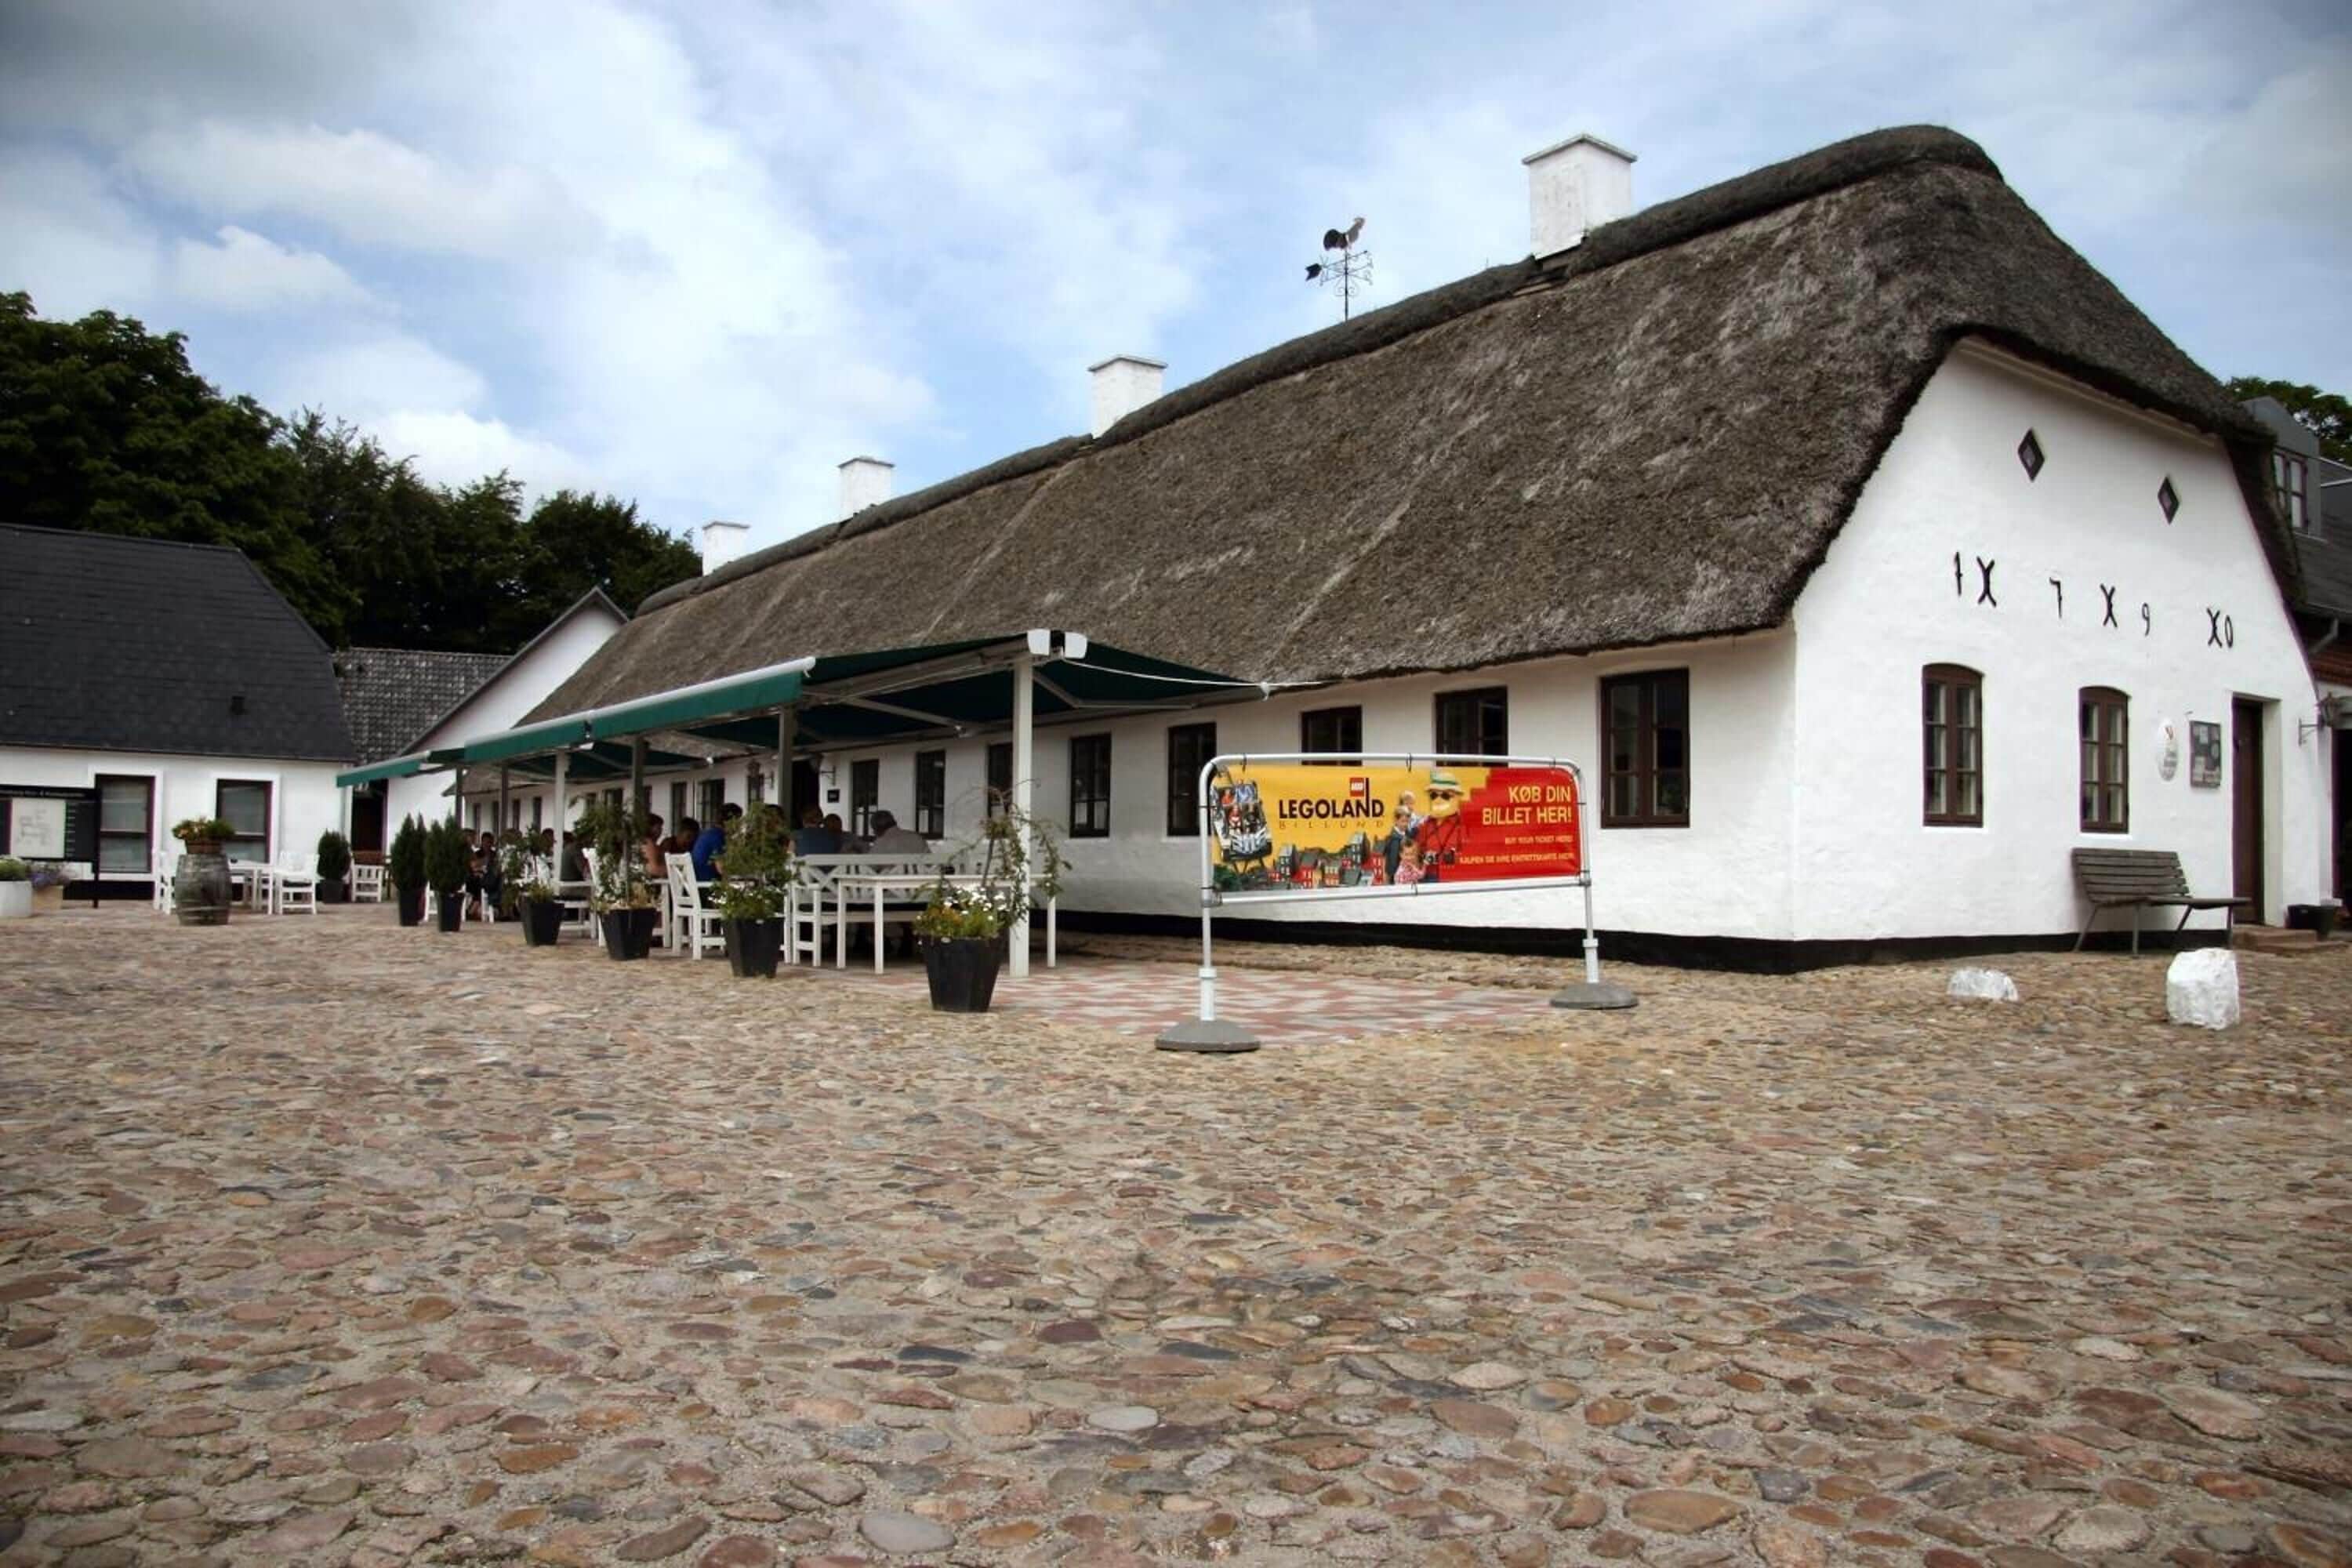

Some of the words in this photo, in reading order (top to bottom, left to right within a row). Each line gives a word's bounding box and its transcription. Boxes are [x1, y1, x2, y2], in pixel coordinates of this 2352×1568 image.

[1279, 778, 1385, 818] LEGOLAND
[1508, 786, 1541, 803] KØB
[1546, 786, 1571, 802] DIN
[1483, 807, 1531, 825] BILLET
[1537, 806, 1572, 823] HER!
